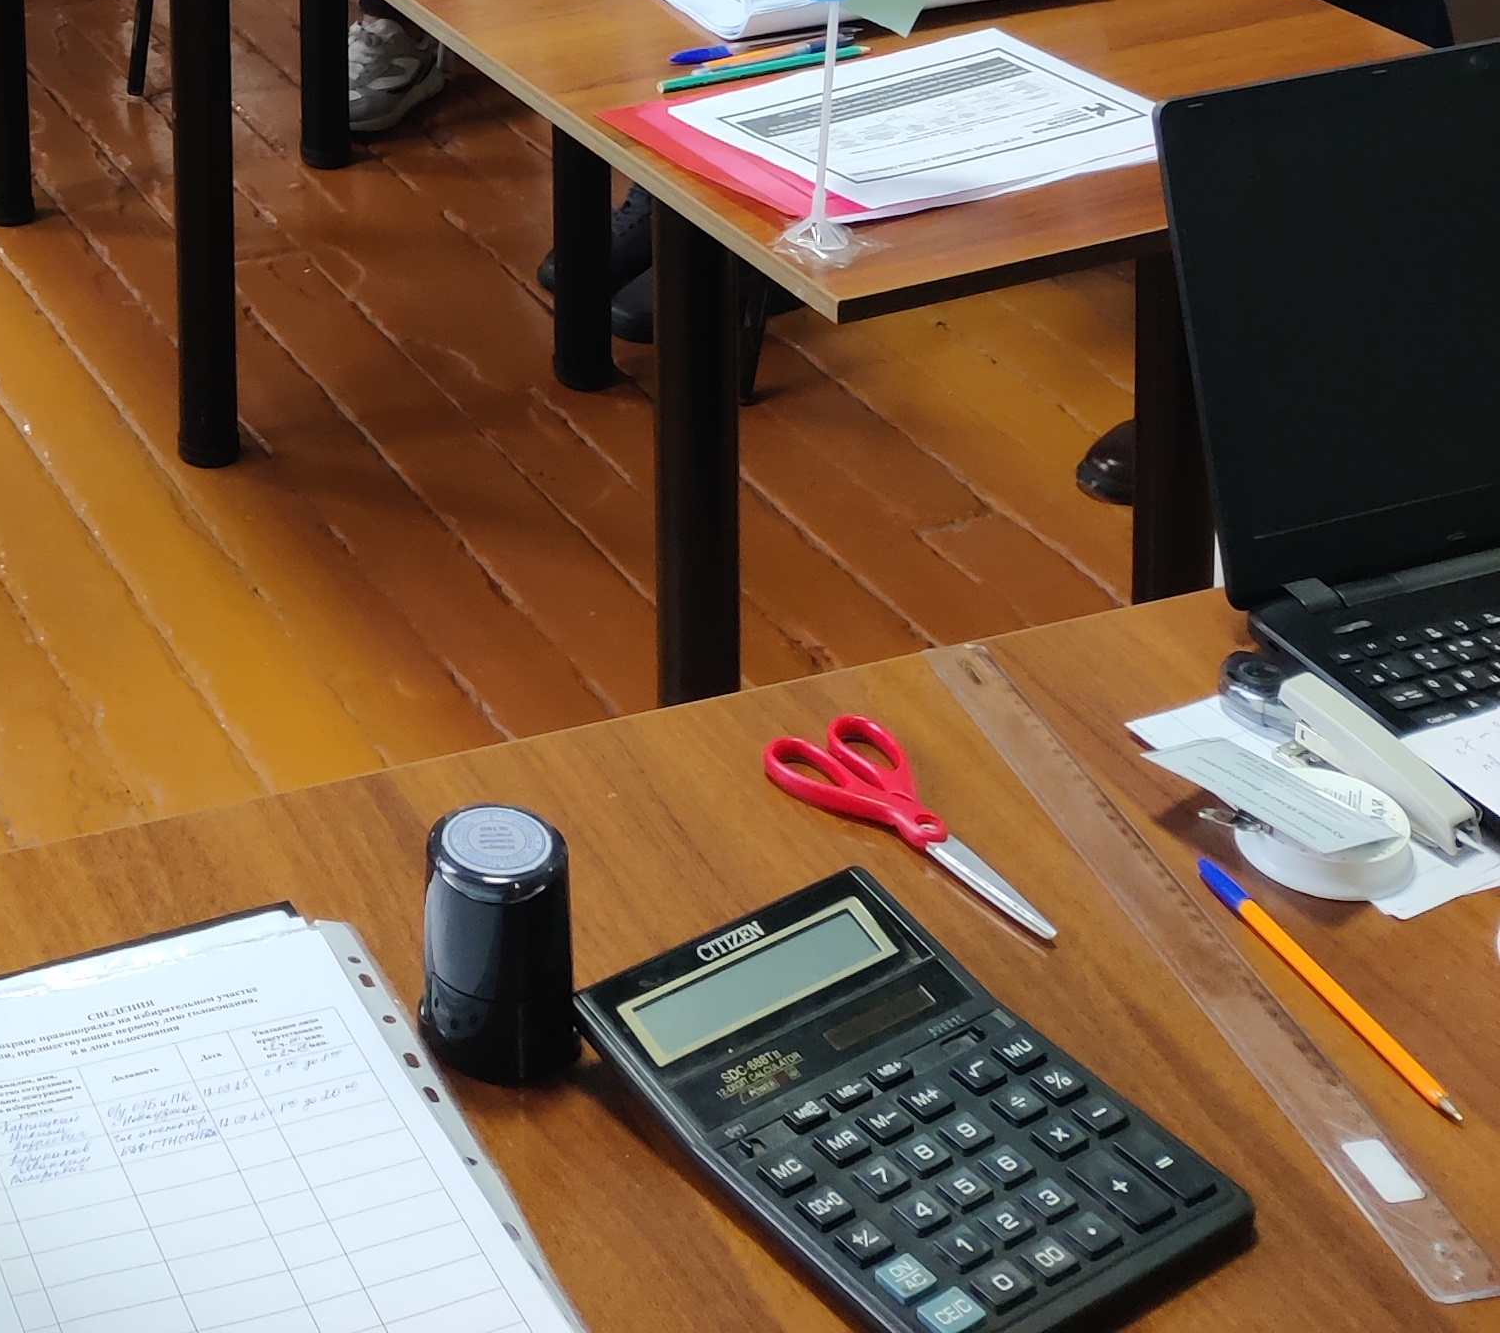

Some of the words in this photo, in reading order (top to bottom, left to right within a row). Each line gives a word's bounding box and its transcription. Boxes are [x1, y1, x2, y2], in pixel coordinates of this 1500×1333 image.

[696, 920, 765, 962] CITIZEN
[38, 1020, 116, 1044] правопорядка
[117, 1017, 131, 1026] на
[132, 995, 215, 1022] избирательном
[216, 985, 259, 1002] участке
[87, 999, 156, 1022] СВЕДЕНИЯ
[16, 1031, 113, 1059] предшествующие
[114, 1019, 161, 1037] первому
[162, 1013, 186, 1027] дню
[186, 997, 259, 1020] голосования,
[89, 1041, 110, 1053] дни
[111, 1025, 180, 1047] голосования
[200, 1051, 223, 1064] Дата
[1003, 1038, 1033, 1059] MU
[110, 1066, 161, 1084] Должность
[749, 1051, 803, 1083] CALCULATOR
[20, 1078, 74, 1094] сотрудника
[5, 1094, 74, 1115] избирательном
[910, 1087, 940, 1108] M+
[18, 1107, 55, 1121] участке
[956, 1121, 977, 1139] 9
[826, 1129, 858, 1151] MR
[913, 1143, 935, 1161] 8
[770, 1158, 802, 1180] MC
[997, 1155, 1018, 1172] 6
[870, 1166, 889, 1184] 7
[953, 1177, 977, 1195] 5
[1038, 1188, 1061, 1207] 3
[914, 1201, 933, 1218] 4
[996, 1213, 1020, 1231] 2
[955, 1237, 974, 1253] 1
[1034, 1245, 1065, 1269] 00
[888, 1262, 914, 1280] ON
[904, 1273, 928, 1291] AC
[992, 1273, 1014, 1291] 0
[934, 1298, 973, 1326] CE/C
